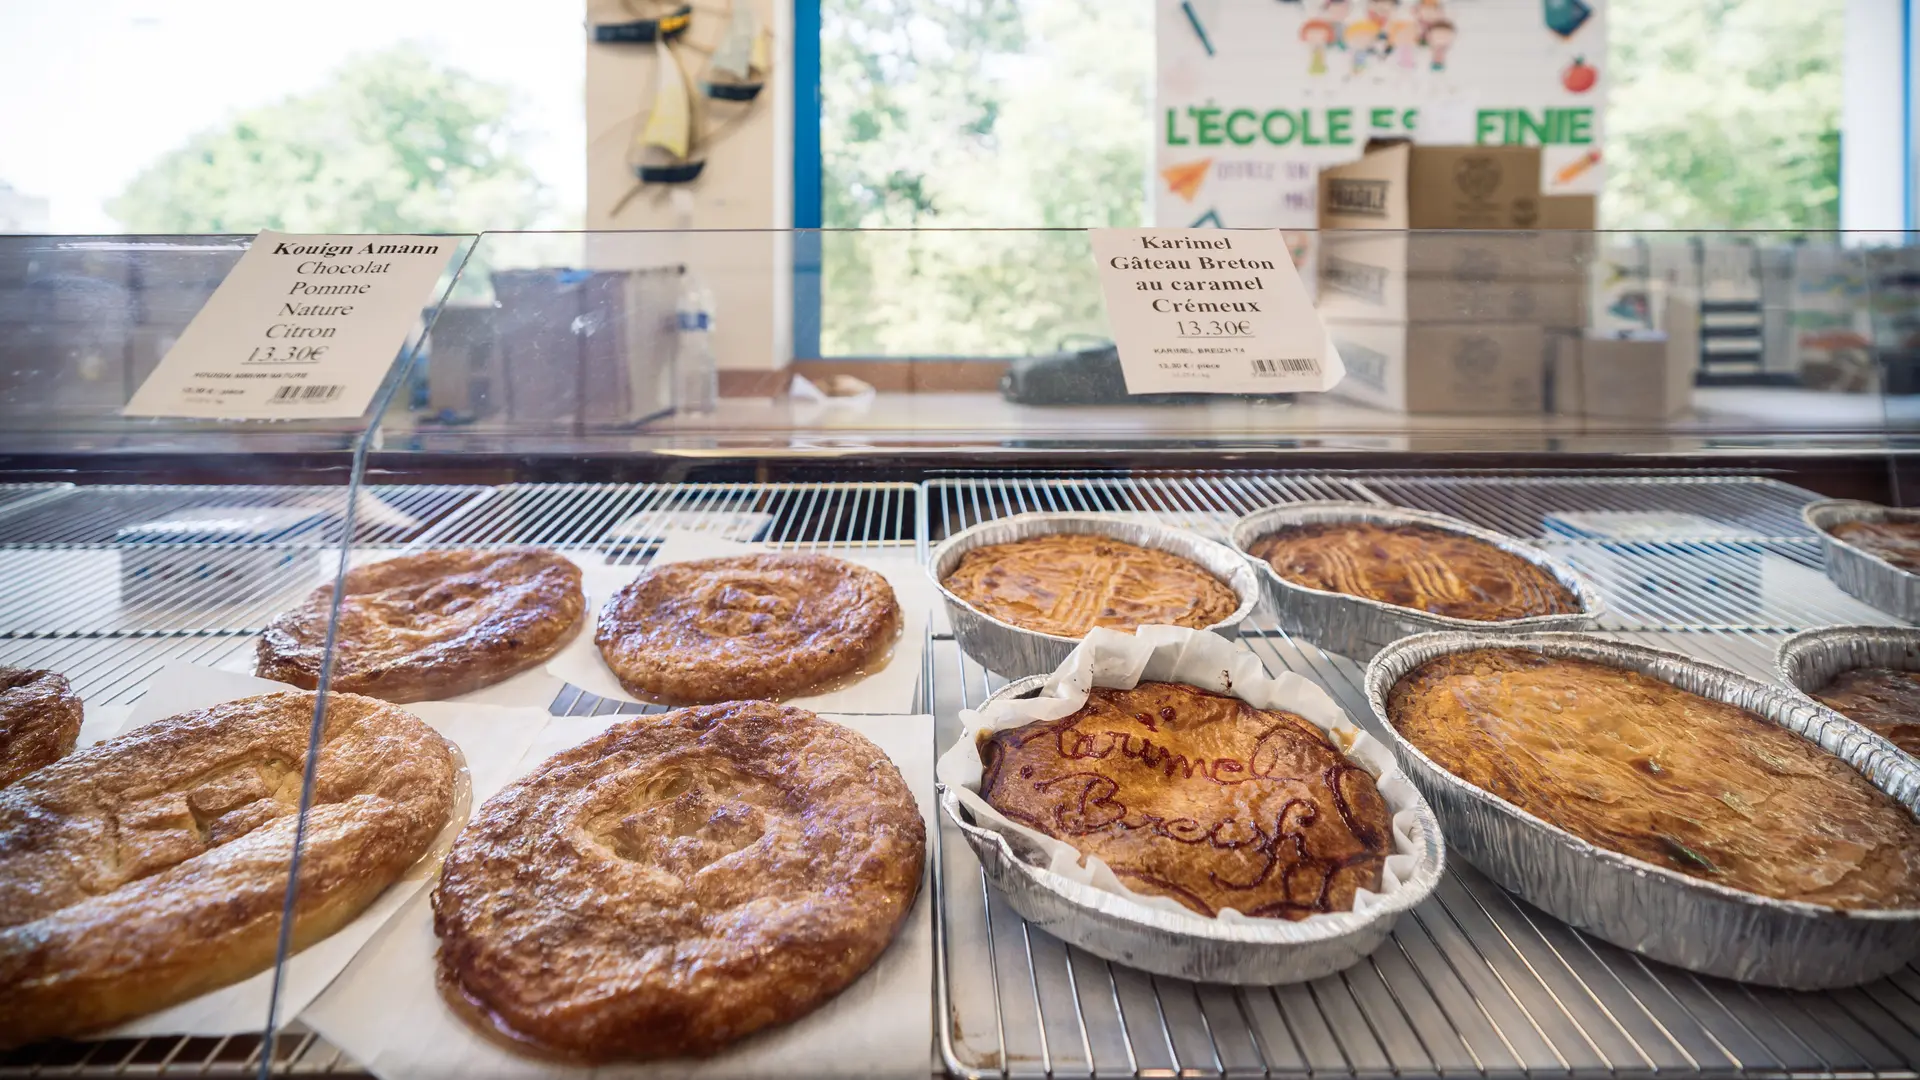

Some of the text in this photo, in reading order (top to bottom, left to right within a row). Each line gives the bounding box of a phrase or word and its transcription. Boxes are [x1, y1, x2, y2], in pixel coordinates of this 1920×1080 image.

[1476, 107, 1594, 145] FINIE
[272, 242, 439, 257] Kouign Amann
[1140, 236, 1232, 250] Karimel
[297, 261, 391, 275] Chocolat
[1110, 256, 1275, 270] Gâteau Breton
[289, 281, 371, 296] Pomme
[1136, 276, 1264, 291] au caramel
[278, 302, 353, 316] Nature
[1152, 297, 1262, 313] Crémeux
[265, 324, 336, 339] Citron
[1176, 320, 1254, 336] 13.30€
[247, 346, 330, 362] 13.30€
